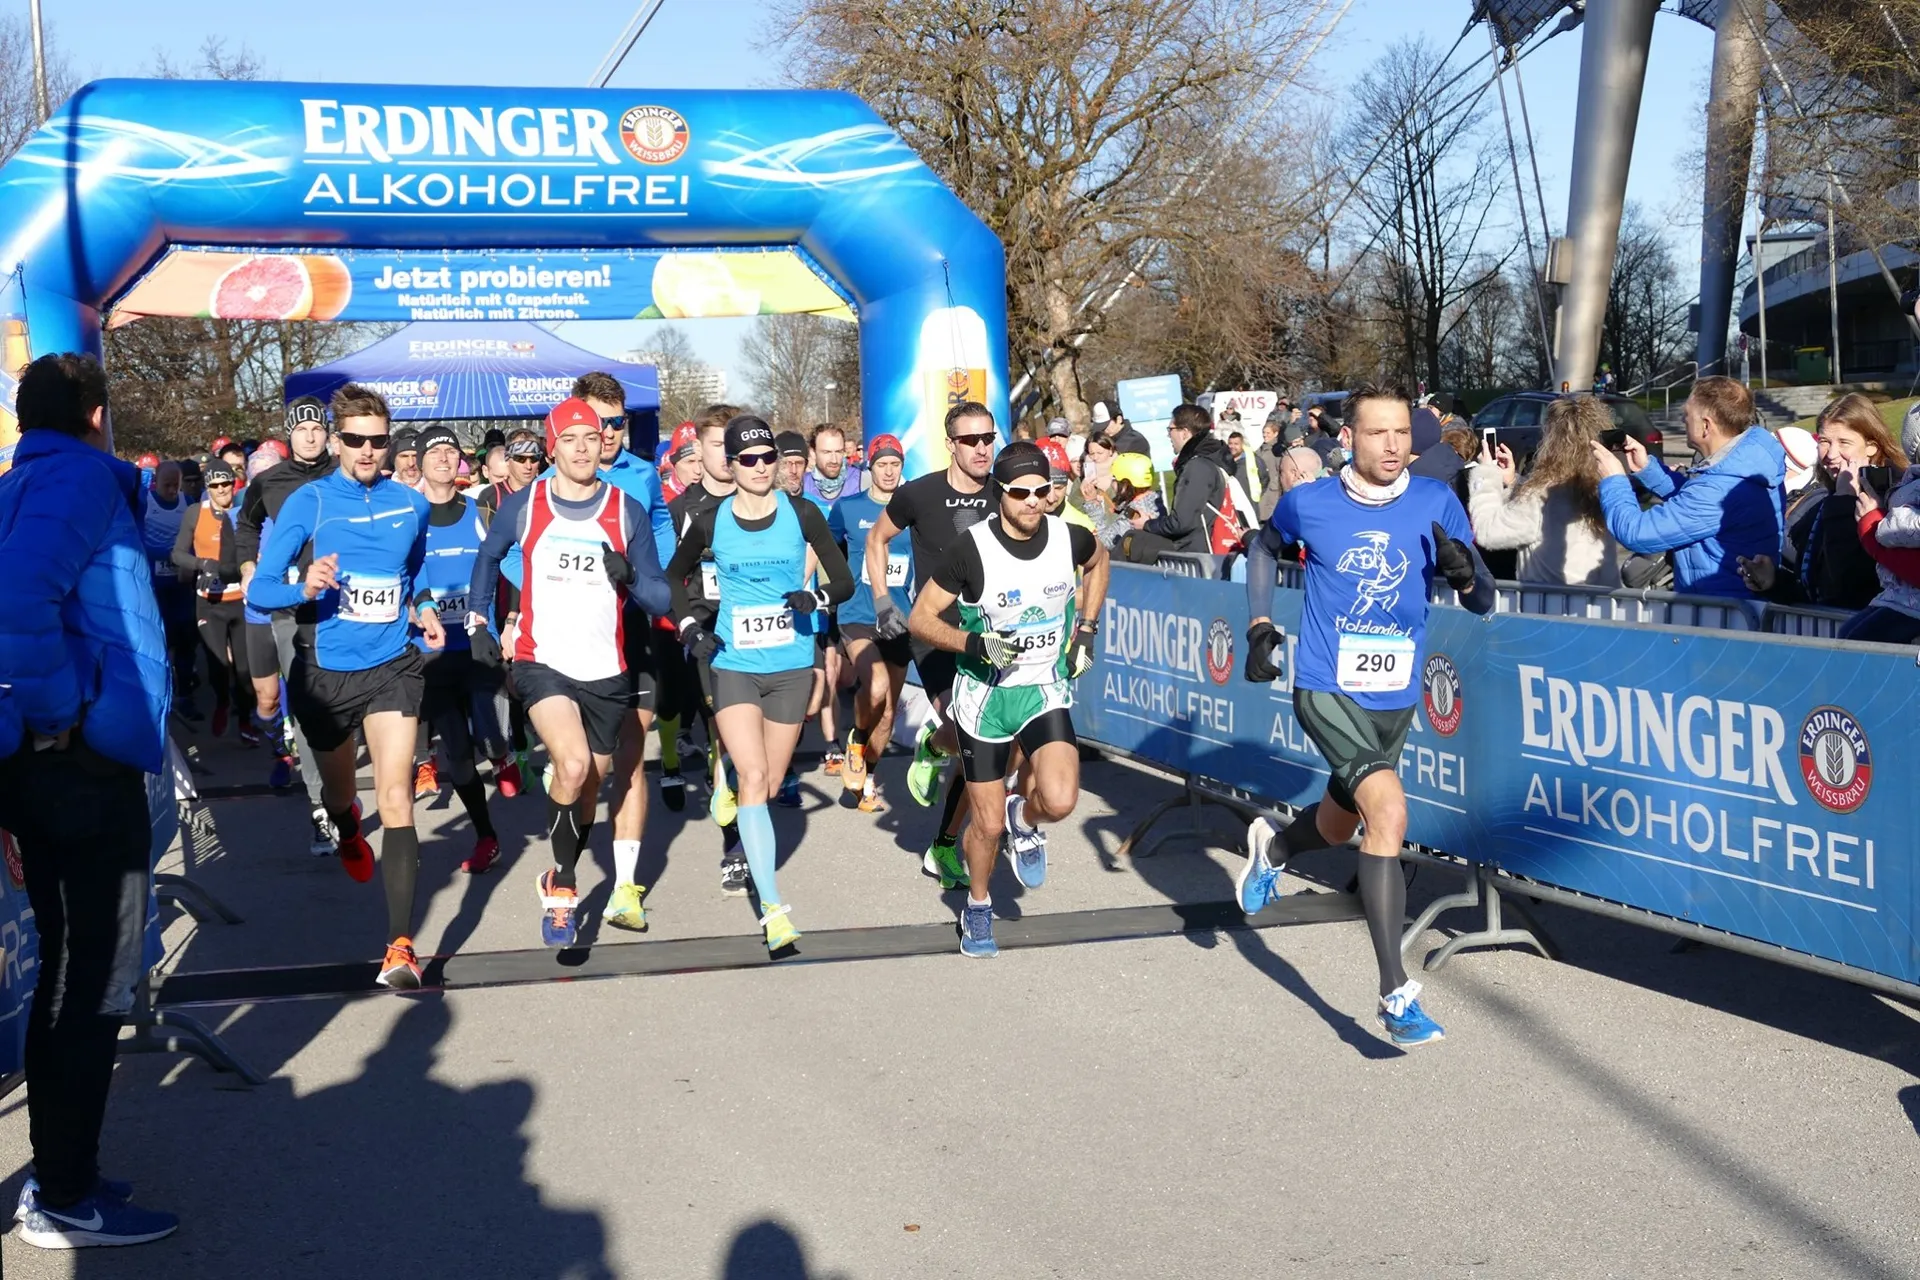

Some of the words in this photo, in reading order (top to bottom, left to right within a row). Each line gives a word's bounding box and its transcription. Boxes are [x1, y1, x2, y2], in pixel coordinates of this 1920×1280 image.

[623, 107, 683, 129] ERDINGER
[300, 98, 623, 165] ERDINGER
[629, 140, 684, 161] WEISSBRÄU
[303, 172, 690, 207] ALKOHOLFREI
[374, 265, 452, 289] Jetzt
[460, 265, 611, 293] probieren!
[398, 292, 472, 307] Natürlich
[475, 293, 502, 306] mit
[505, 292, 590, 307] Grapefruit.
[411, 307, 484, 320] Natürlich
[488, 307, 515, 320] mit
[517, 307, 580, 320] Zitrone.
[408, 338, 512, 352] ERDINGER
[509, 376, 578, 392] ERDINGE
[1229, 396, 1266, 410] AVIS
[740, 428, 772, 442] GORE
[558, 553, 595, 573] 512
[350, 588, 396, 606] 1641
[741, 614, 788, 633] 1376
[1012, 631, 1057, 651] 1635
[1104, 598, 1206, 683] ERDINGER
[1355, 653, 1397, 673] 290
[1424, 656, 1460, 693] ERDINGER
[1103, 671, 1235, 734] ALKOHOLFREI
[1427, 704, 1460, 733] WEISSBRÄU
[1517, 663, 1799, 806] ERDINGER
[1802, 711, 1866, 757] ERDINGER
[1807, 769, 1867, 806] WEISSBRÄU
[1523, 772, 1876, 890] ALKOHOLFREI
